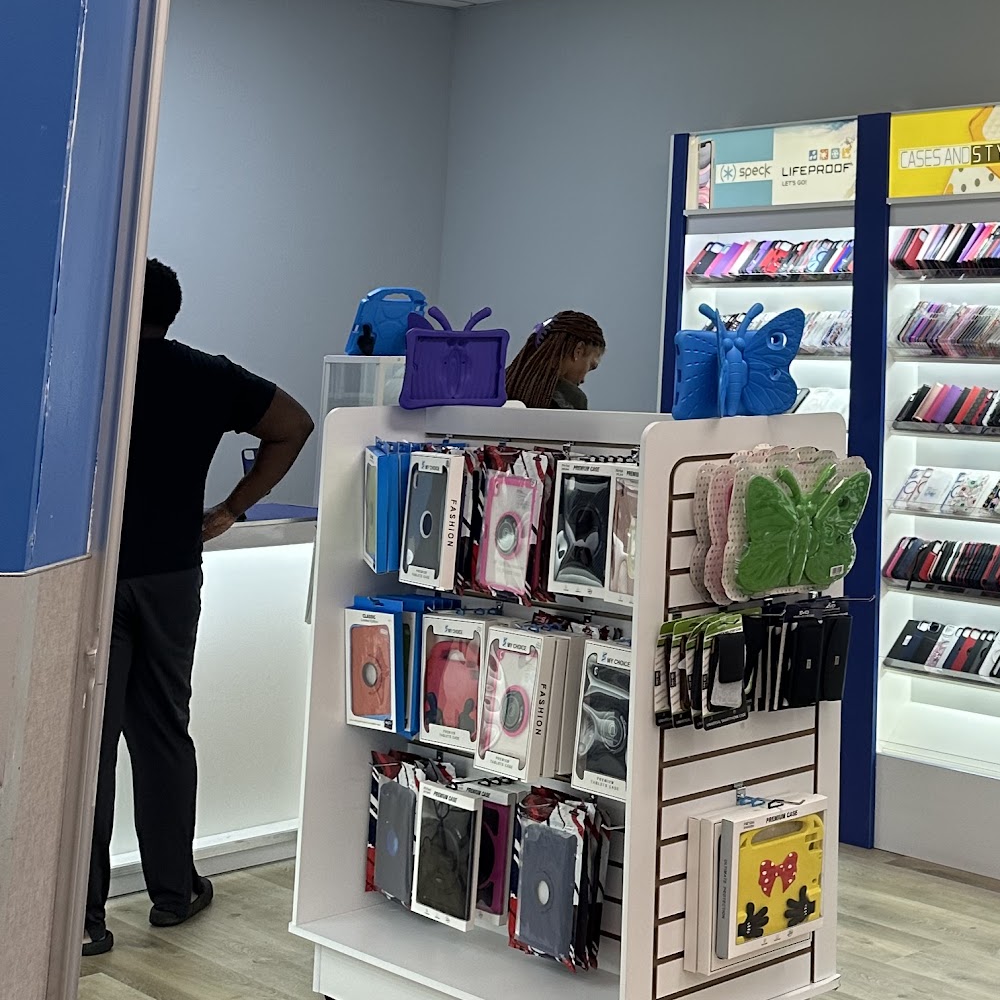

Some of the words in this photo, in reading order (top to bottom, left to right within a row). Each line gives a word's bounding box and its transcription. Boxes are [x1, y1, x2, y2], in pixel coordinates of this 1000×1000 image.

[900, 148, 941, 168] CASES
[944, 146, 970, 165] AND
[739, 163, 772, 179] speck
[781, 163, 851, 177] LIFEPROOF
[447, 499, 458, 547] FASHION
[613, 658, 631, 667] CHOICE
[535, 683, 547, 736] FASHION
[766, 812, 786, 824] PREMIUM
[786, 809, 798, 818] CASE
